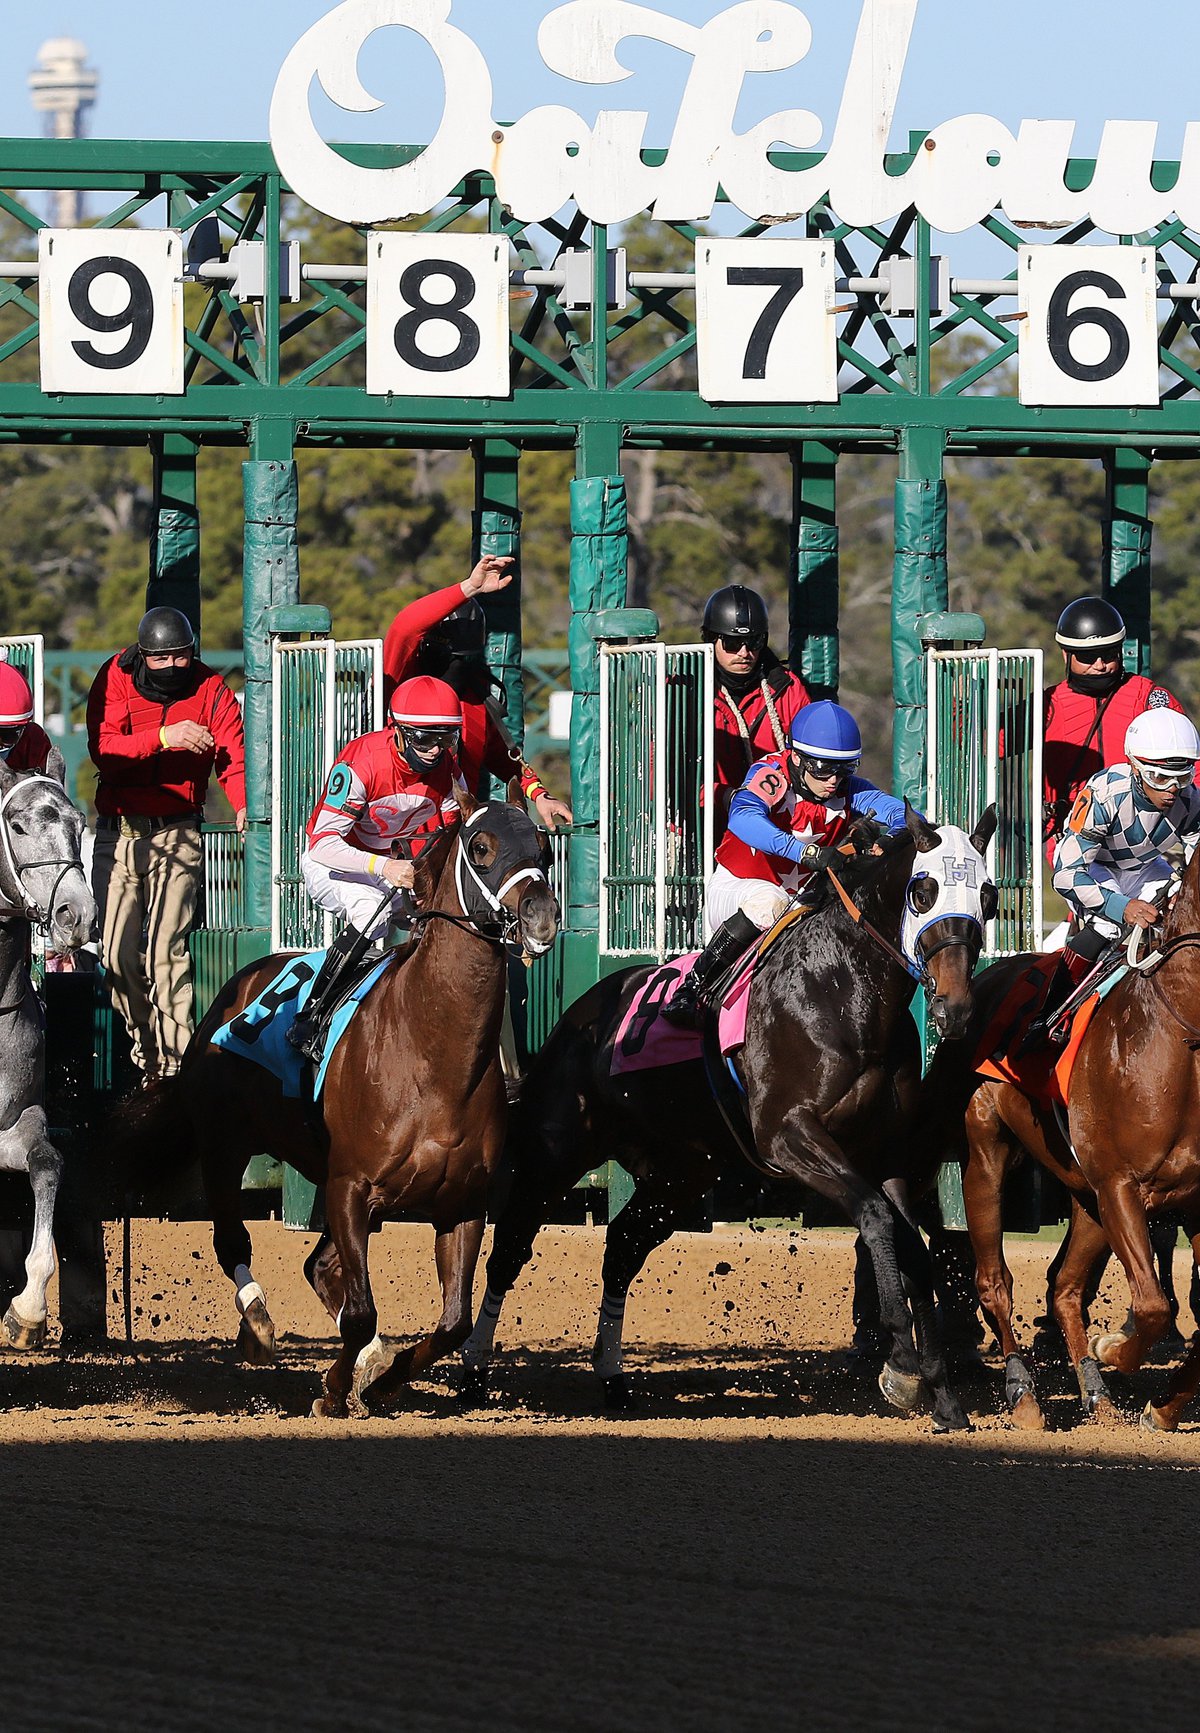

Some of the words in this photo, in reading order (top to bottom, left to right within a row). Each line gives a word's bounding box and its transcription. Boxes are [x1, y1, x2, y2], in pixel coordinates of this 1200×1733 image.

[68, 256, 153, 369] 9
[394, 259, 480, 372] 8
[727, 267, 803, 379] 7
[1047, 271, 1129, 381] 6
[329, 772, 345, 796] 9
[759, 774, 782, 796] 8
[1075, 796, 1088, 820] 7
[230, 961, 316, 1044] 9
[621, 967, 681, 1057] 8
